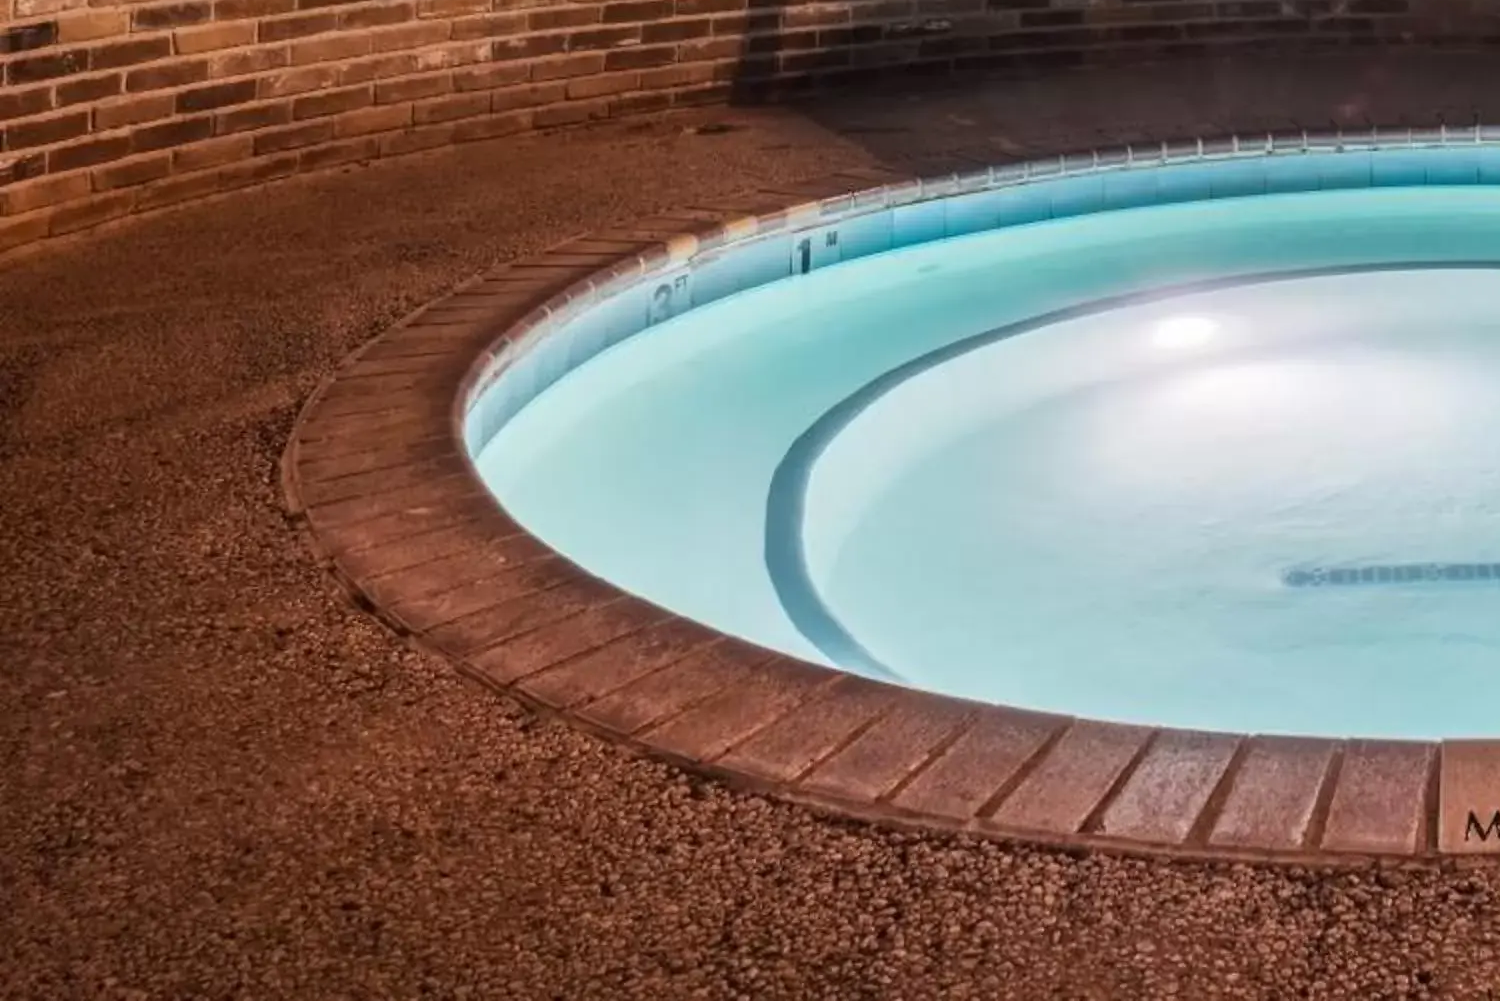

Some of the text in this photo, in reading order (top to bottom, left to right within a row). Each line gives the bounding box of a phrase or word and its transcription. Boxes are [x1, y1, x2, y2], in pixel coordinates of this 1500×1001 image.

[798, 230, 838, 274] 1 M
[674, 274, 689, 290] FT
